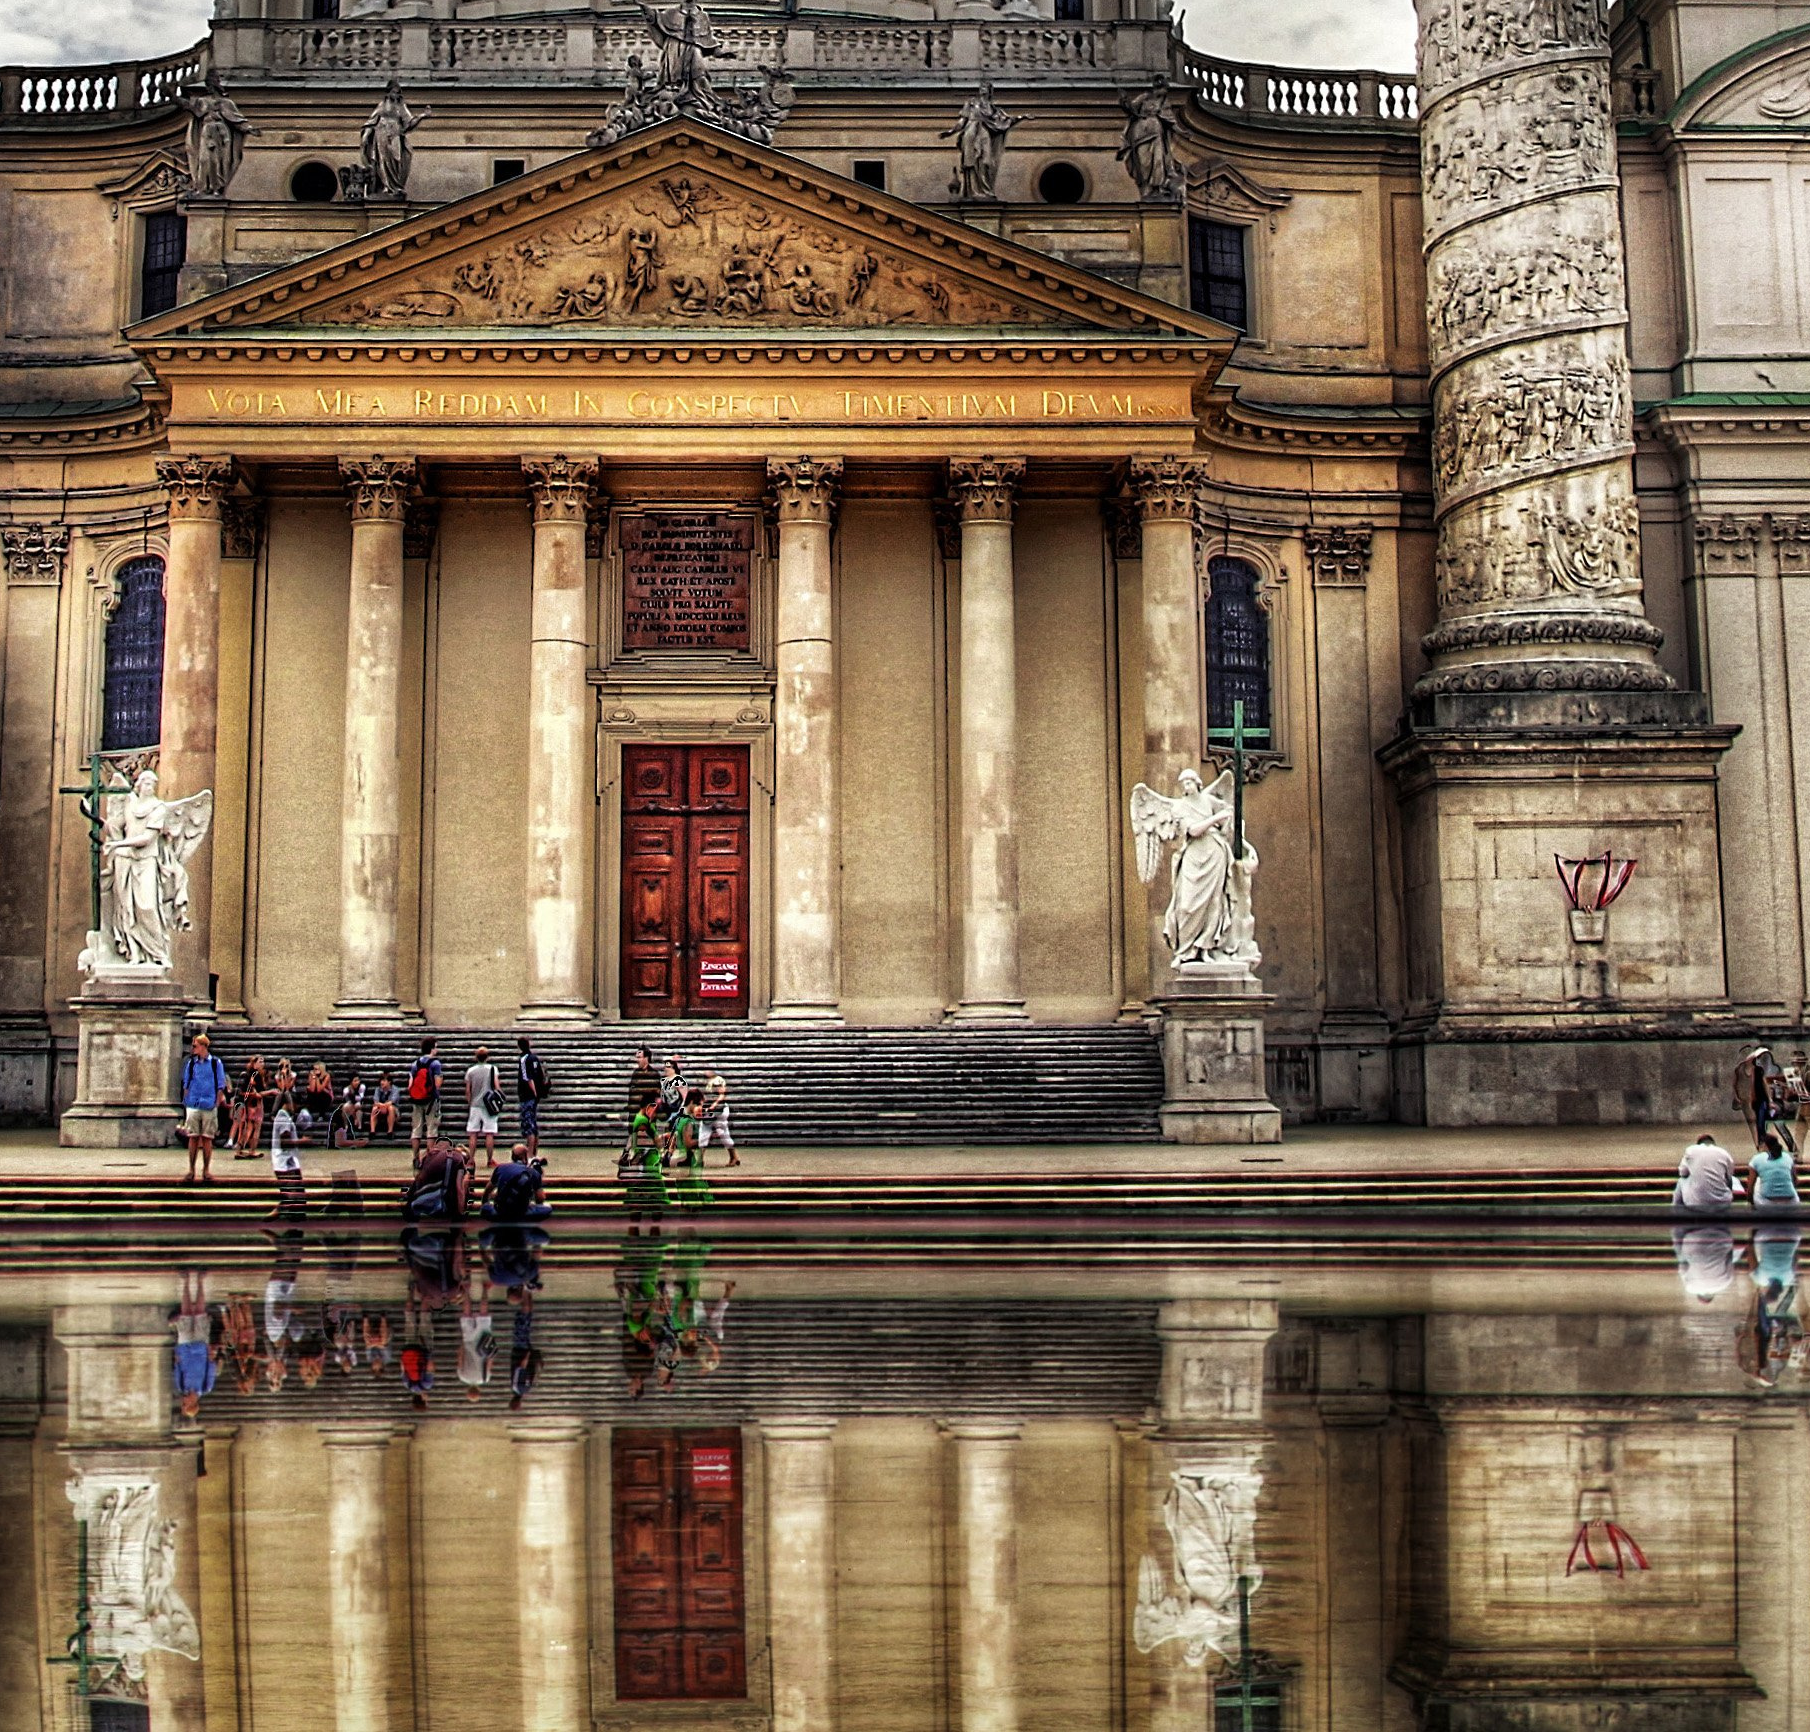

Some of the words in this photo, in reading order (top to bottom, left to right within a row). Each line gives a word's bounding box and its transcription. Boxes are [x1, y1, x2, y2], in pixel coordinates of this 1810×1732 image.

[207, 389, 287, 415] VOTA
[315, 389, 387, 416] MEA
[413, 389, 547, 417] REDDAM
[573, 390, 602, 416] IN
